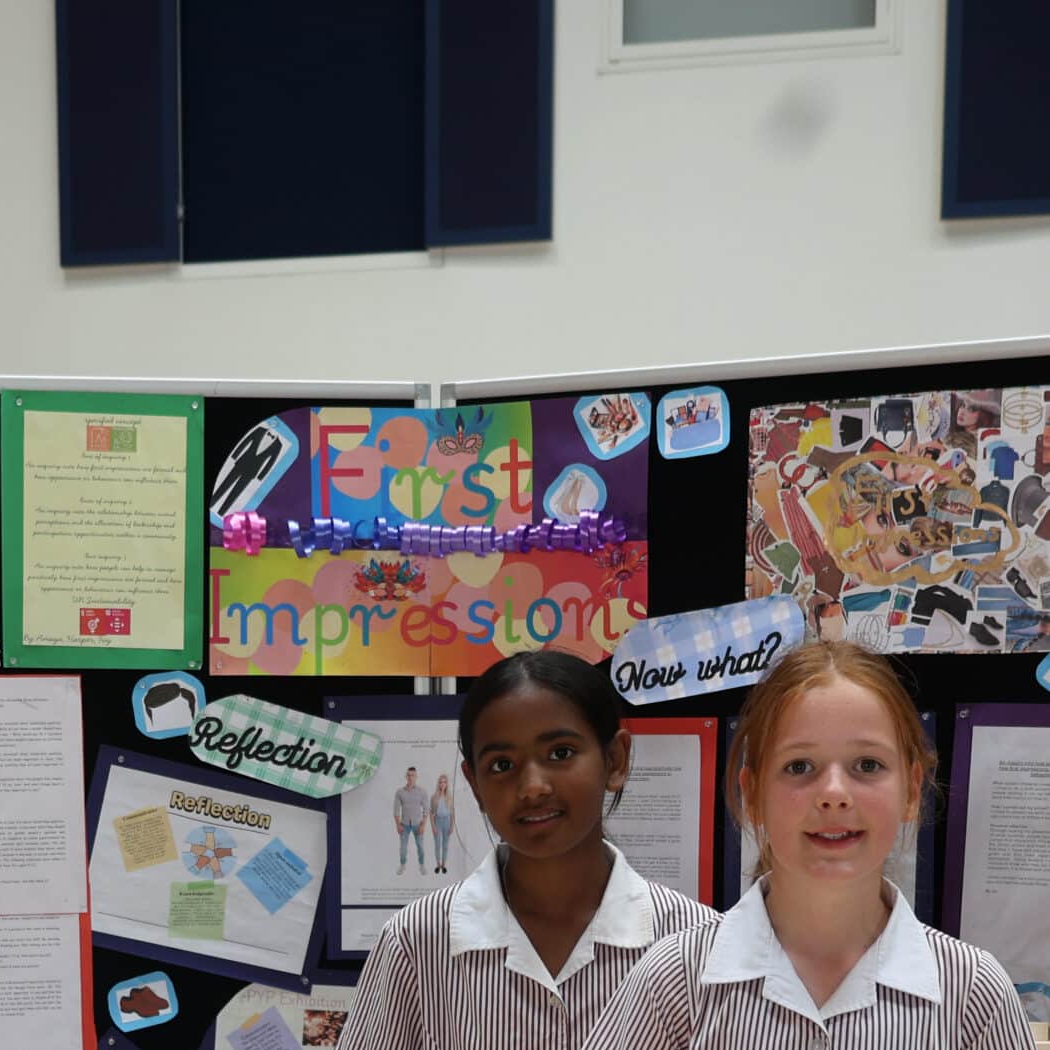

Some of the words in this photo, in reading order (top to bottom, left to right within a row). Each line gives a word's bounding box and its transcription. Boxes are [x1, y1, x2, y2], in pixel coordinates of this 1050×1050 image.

[616, 658, 687, 694] Now
[697, 631, 782, 682] what?
[189, 716, 347, 779] Reflection
[170, 790, 271, 829] Reflection
